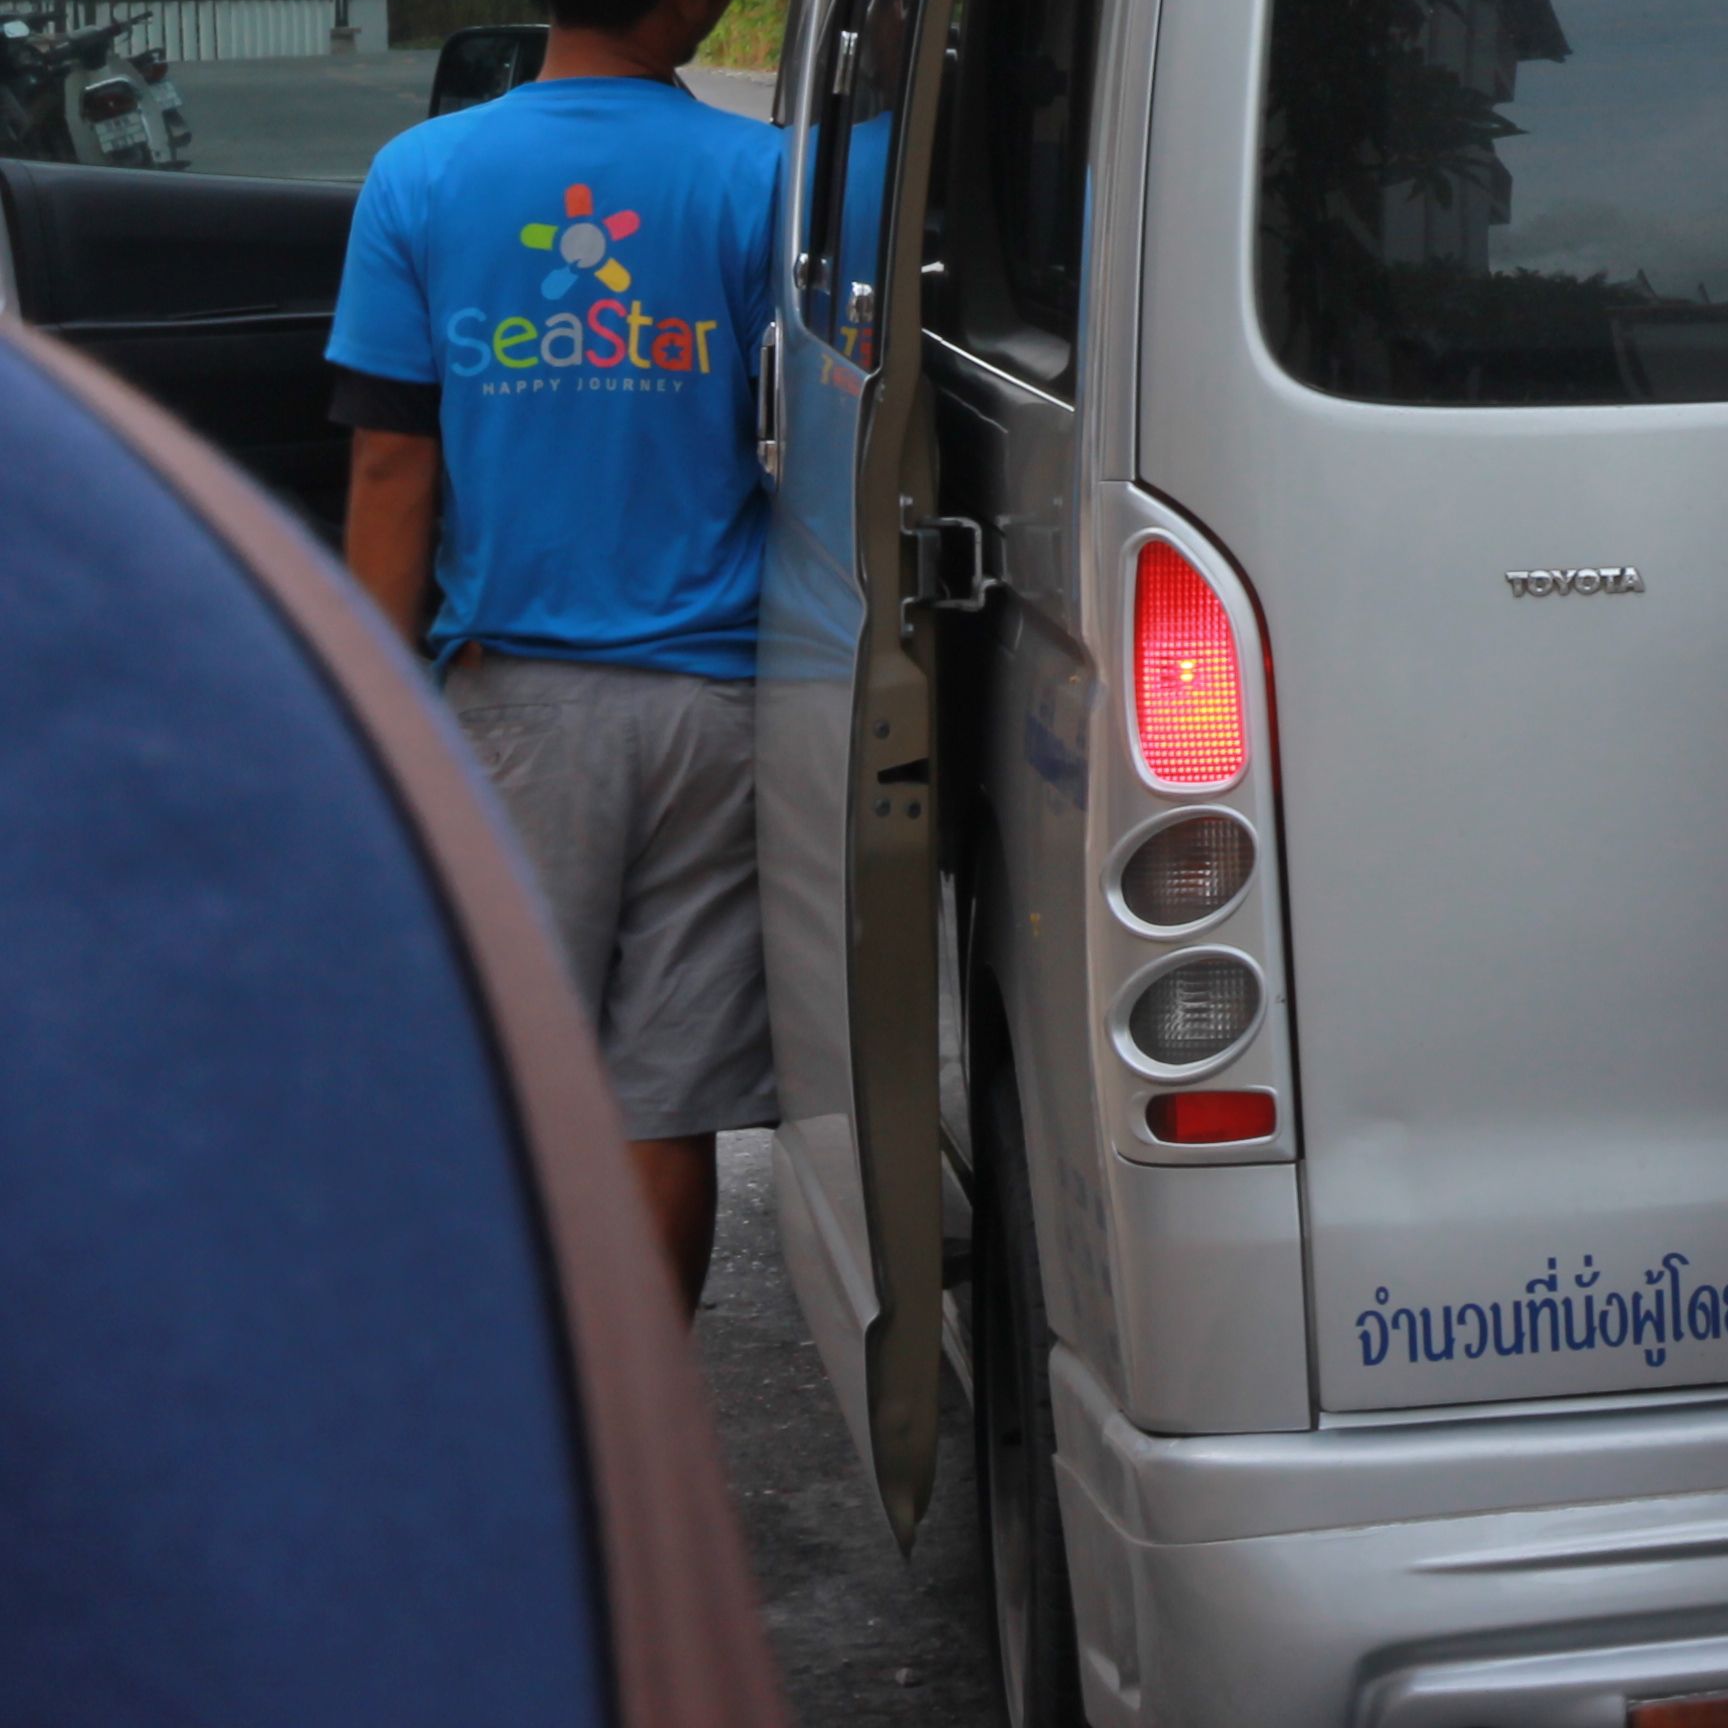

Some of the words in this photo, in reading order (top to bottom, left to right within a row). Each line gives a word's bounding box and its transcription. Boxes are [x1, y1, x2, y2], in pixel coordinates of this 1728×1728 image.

[482, 378, 562, 396] HAPPY
[577, 377, 684, 393] JOURNEY
[1504, 566, 1646, 598] TOYOTA
